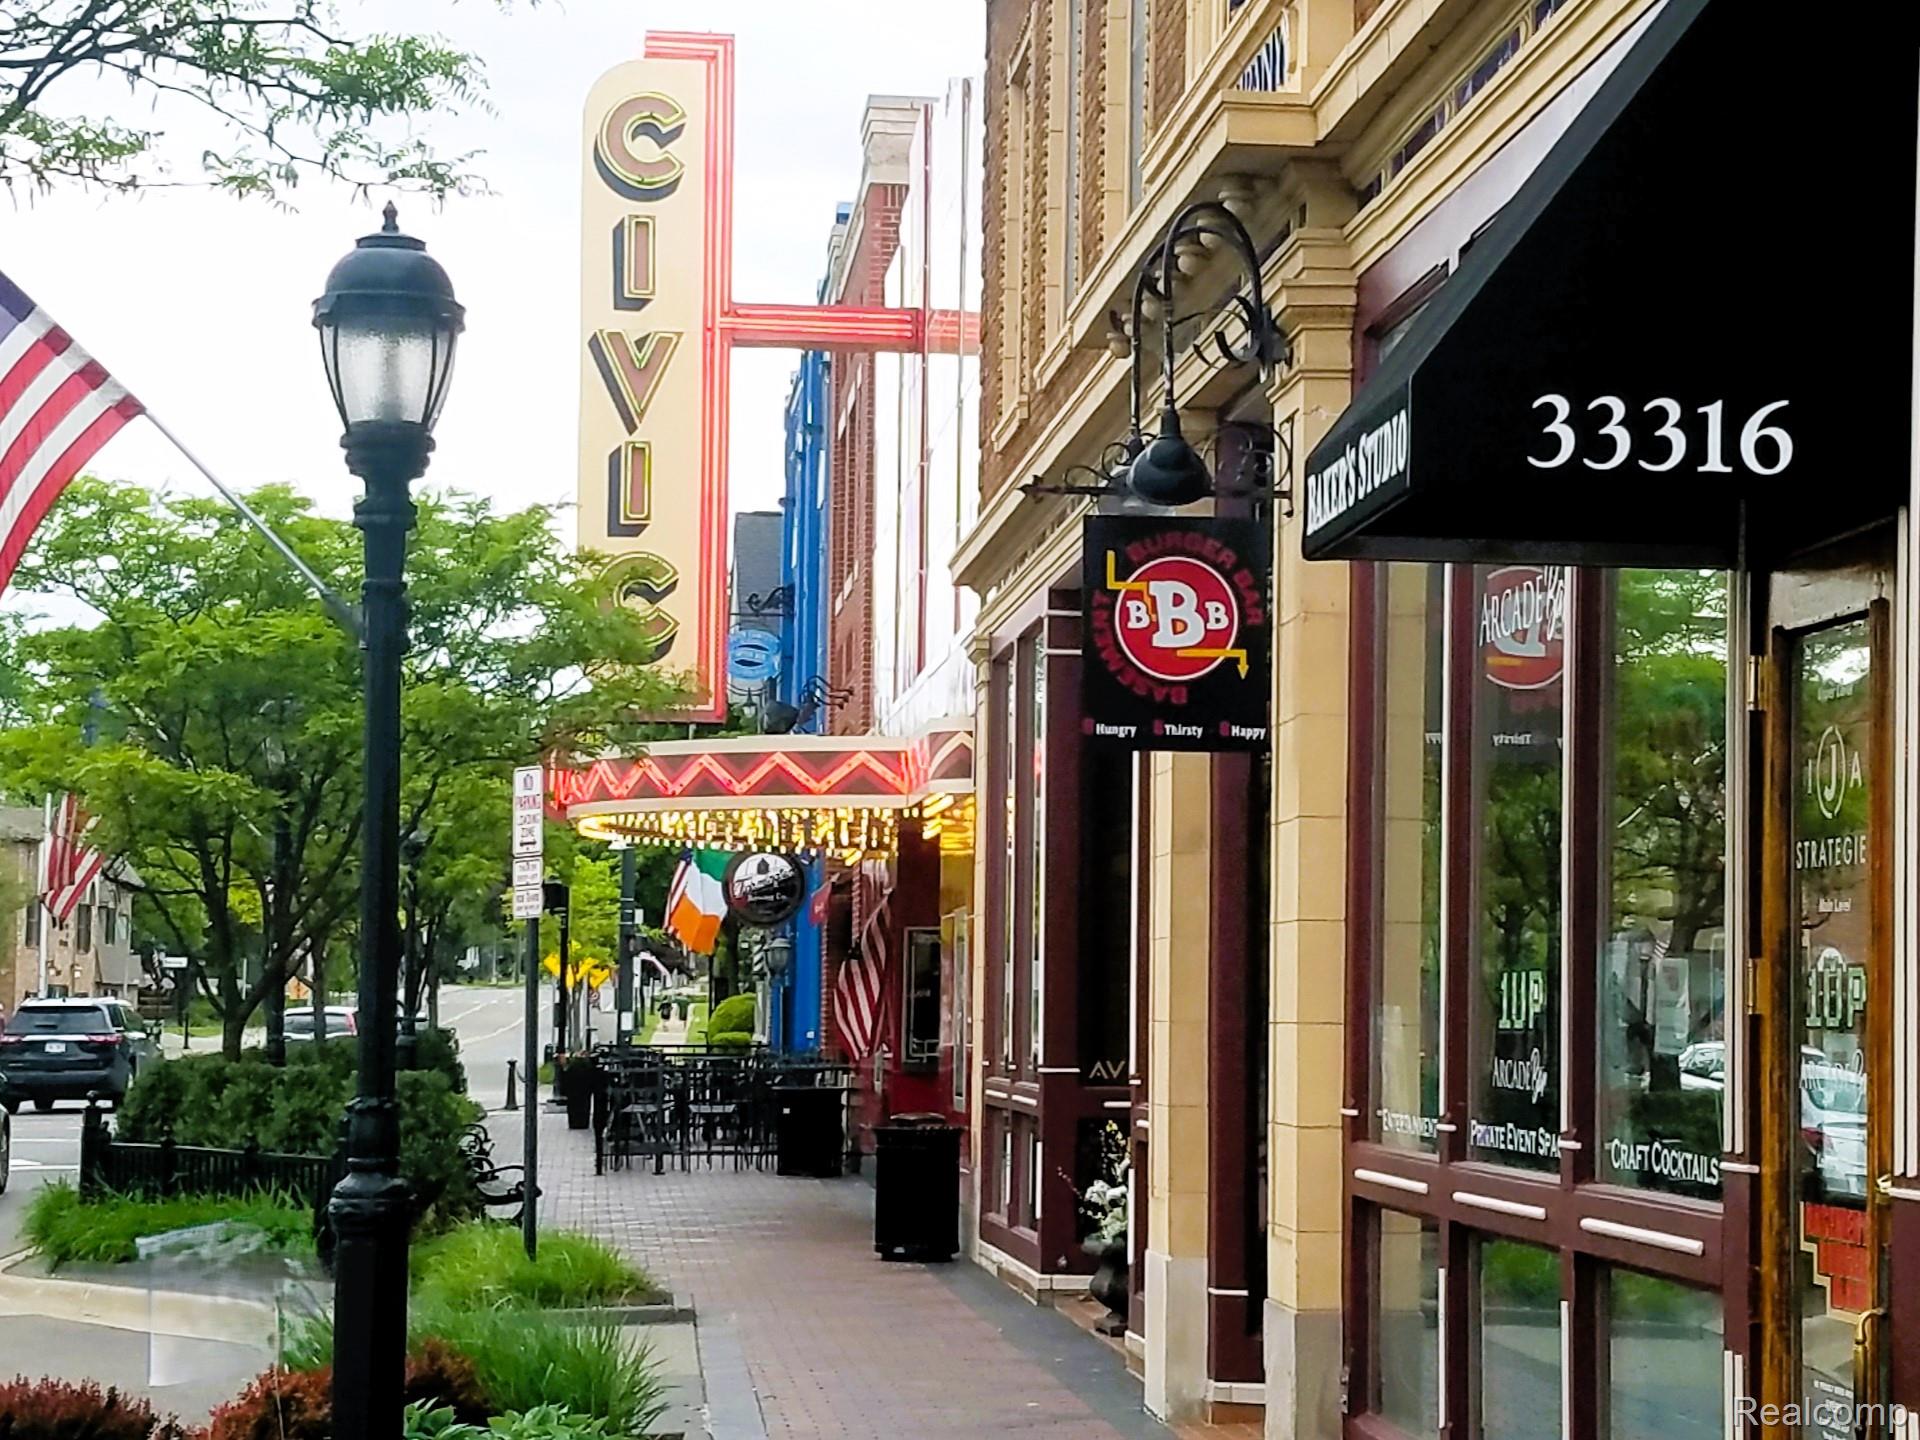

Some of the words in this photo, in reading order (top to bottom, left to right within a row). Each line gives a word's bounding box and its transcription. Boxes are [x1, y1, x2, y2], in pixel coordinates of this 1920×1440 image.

[591, 92, 687, 666] CIVIC
[1526, 394, 1794, 476] 33316
[1306, 442, 1356, 537] BAKER'S
[1358, 409, 1408, 501] STUDIO
[1479, 574, 1543, 648] ARCADE
[1096, 723, 1137, 739] Hungry
[1164, 723, 1203, 739] Thirsty
[1231, 724, 1267, 740] Happy
[1796, 835, 1867, 869] STRATEGIE
[1499, 970, 1544, 1029] 1UP
[1491, 1056, 1531, 1090] ARCADE
[1470, 1119, 1506, 1150] PRIVATE
[1506, 1122, 1537, 1155] EVENT
[1611, 1138, 1650, 1171] CRAFT
[1651, 1141, 1720, 1186] COCKTAILS
